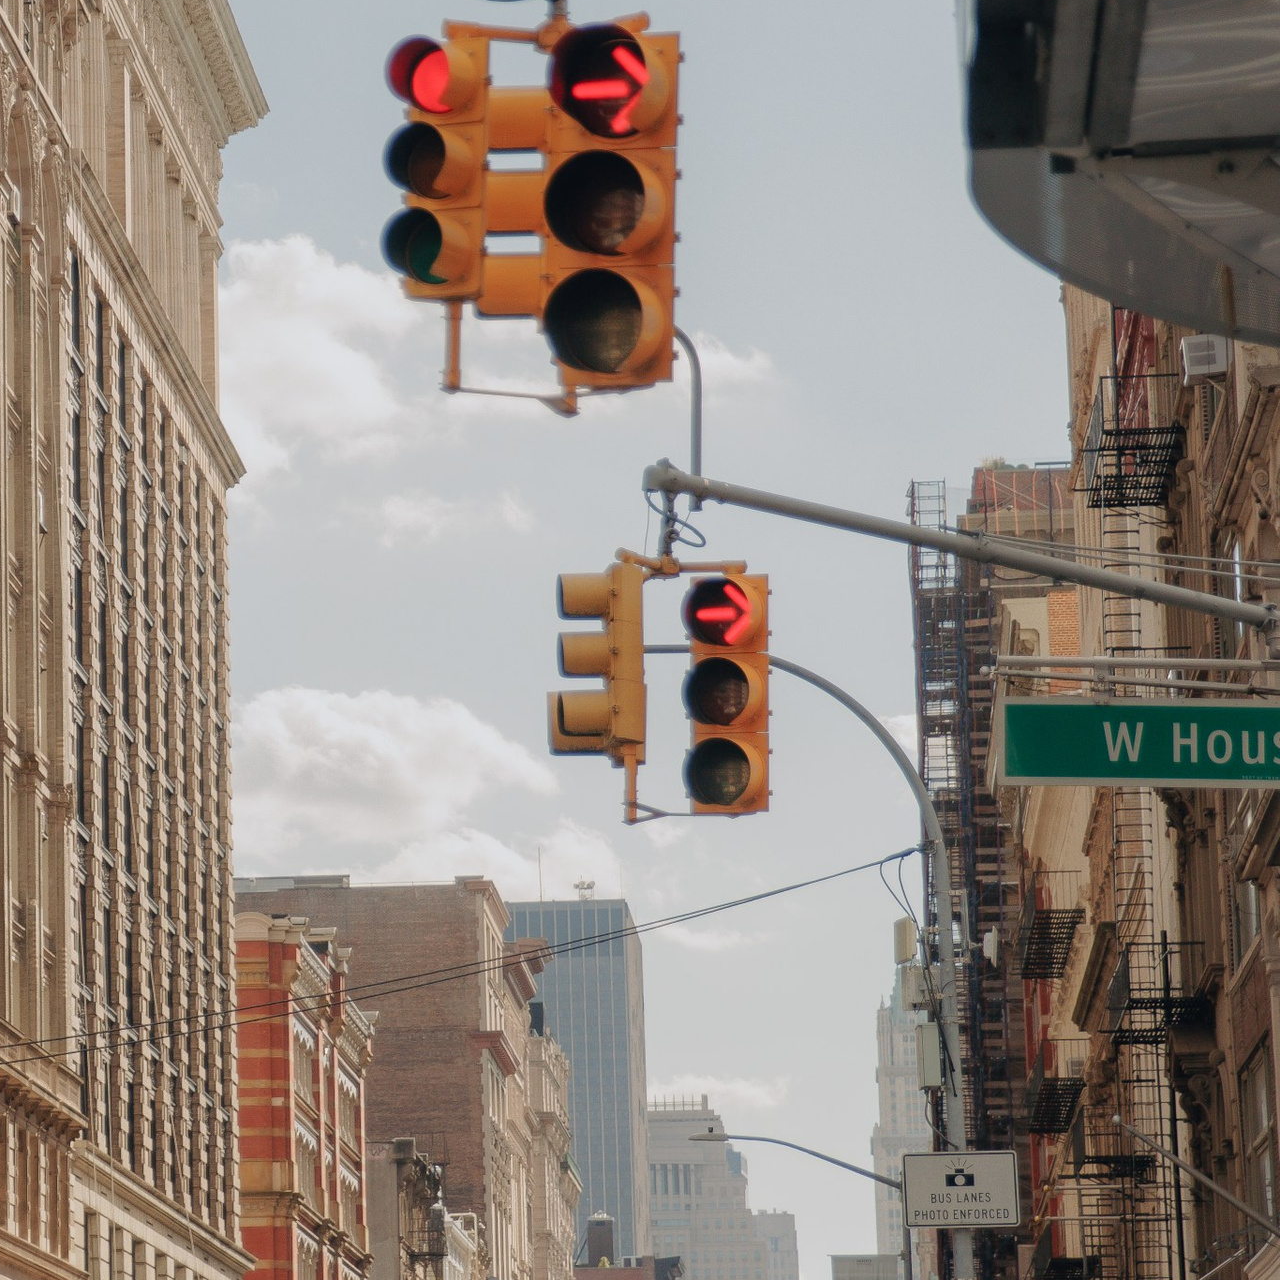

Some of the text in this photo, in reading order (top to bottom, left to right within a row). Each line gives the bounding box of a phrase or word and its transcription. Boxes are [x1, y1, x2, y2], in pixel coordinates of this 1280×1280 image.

[1102, 721, 1144, 762] W
[930, 1192, 991, 1203] BUS LANES
[914, 1208, 1010, 1221] PHOTO ENFORCED
